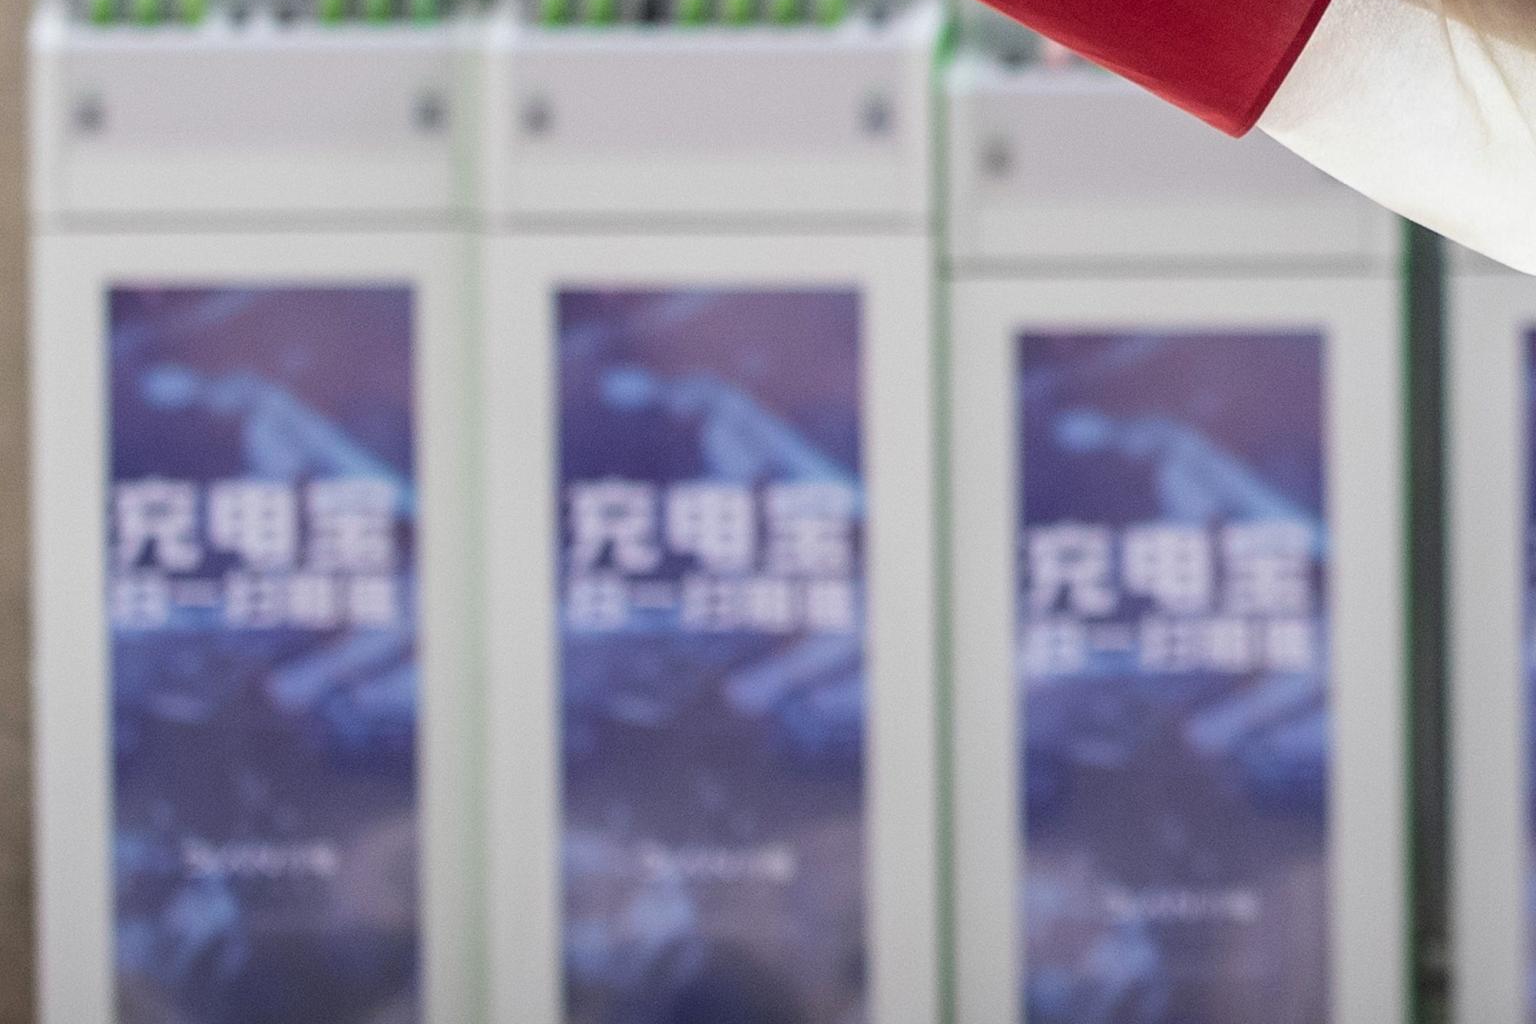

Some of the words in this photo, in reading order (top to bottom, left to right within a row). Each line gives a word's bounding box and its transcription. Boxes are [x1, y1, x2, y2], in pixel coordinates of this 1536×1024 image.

[115, 478, 395, 572] 充电宝
[569, 479, 855, 574] 充电宝
[1025, 523, 1311, 618] 充电宝
